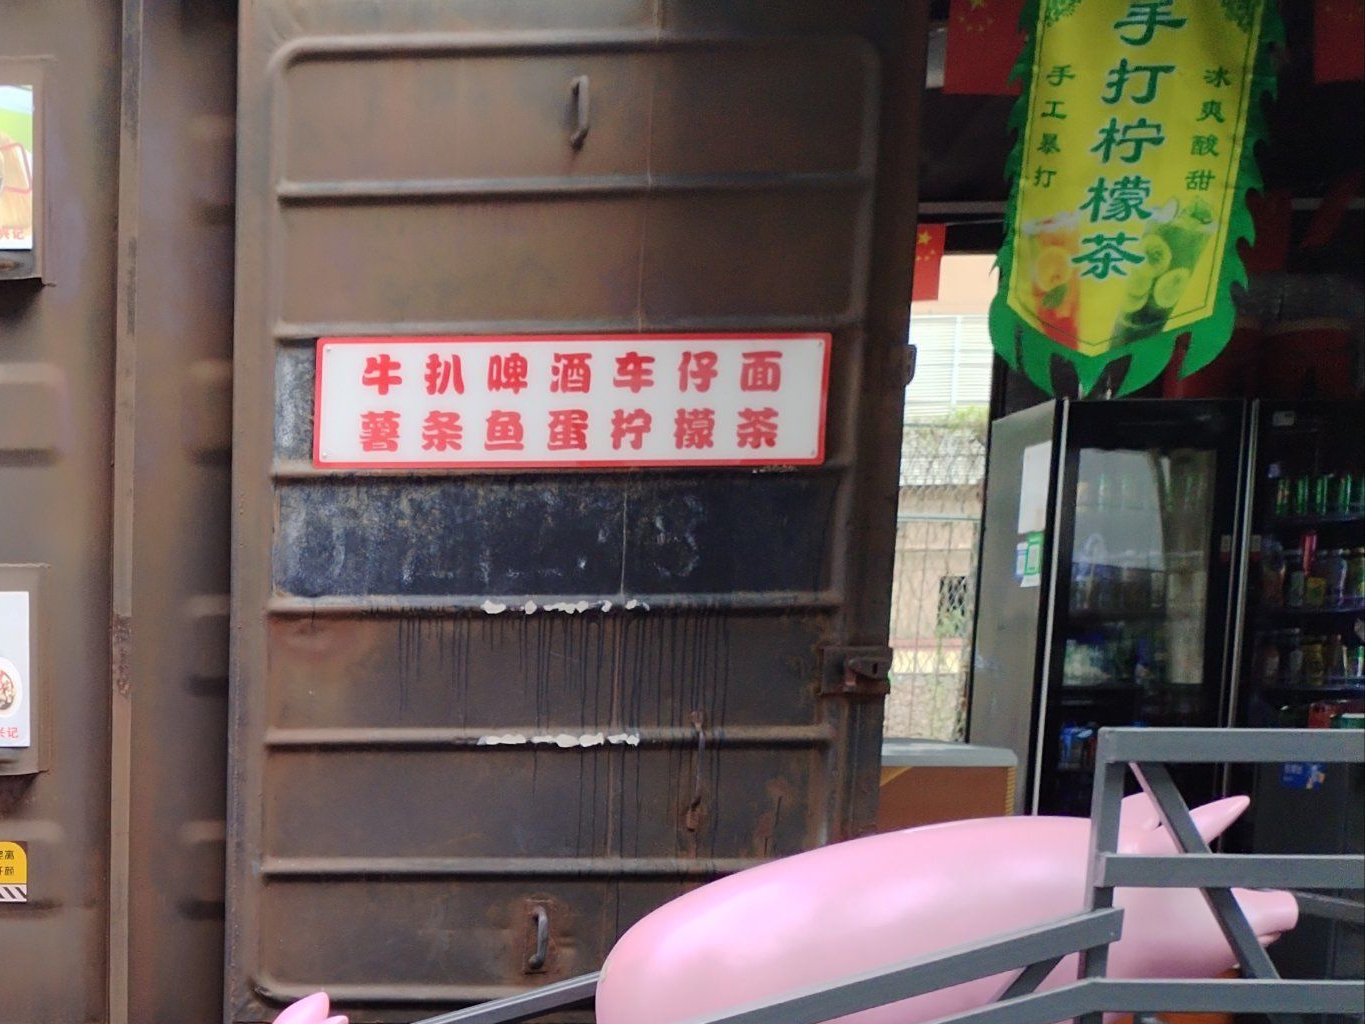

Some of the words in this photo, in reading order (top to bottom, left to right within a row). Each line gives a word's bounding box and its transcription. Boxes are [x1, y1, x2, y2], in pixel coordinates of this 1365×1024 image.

[1033, 64, 1077, 189] 手工暴打
[1071, 0, 1187, 280] 手打柠檬茶
[1185, 65, 1233, 192] 冰爽酸甜
[359, 407, 779, 452] 薯条鱼蛋柠檬茶
[361, 351, 783, 396] 牛扒啤酒车仔面
